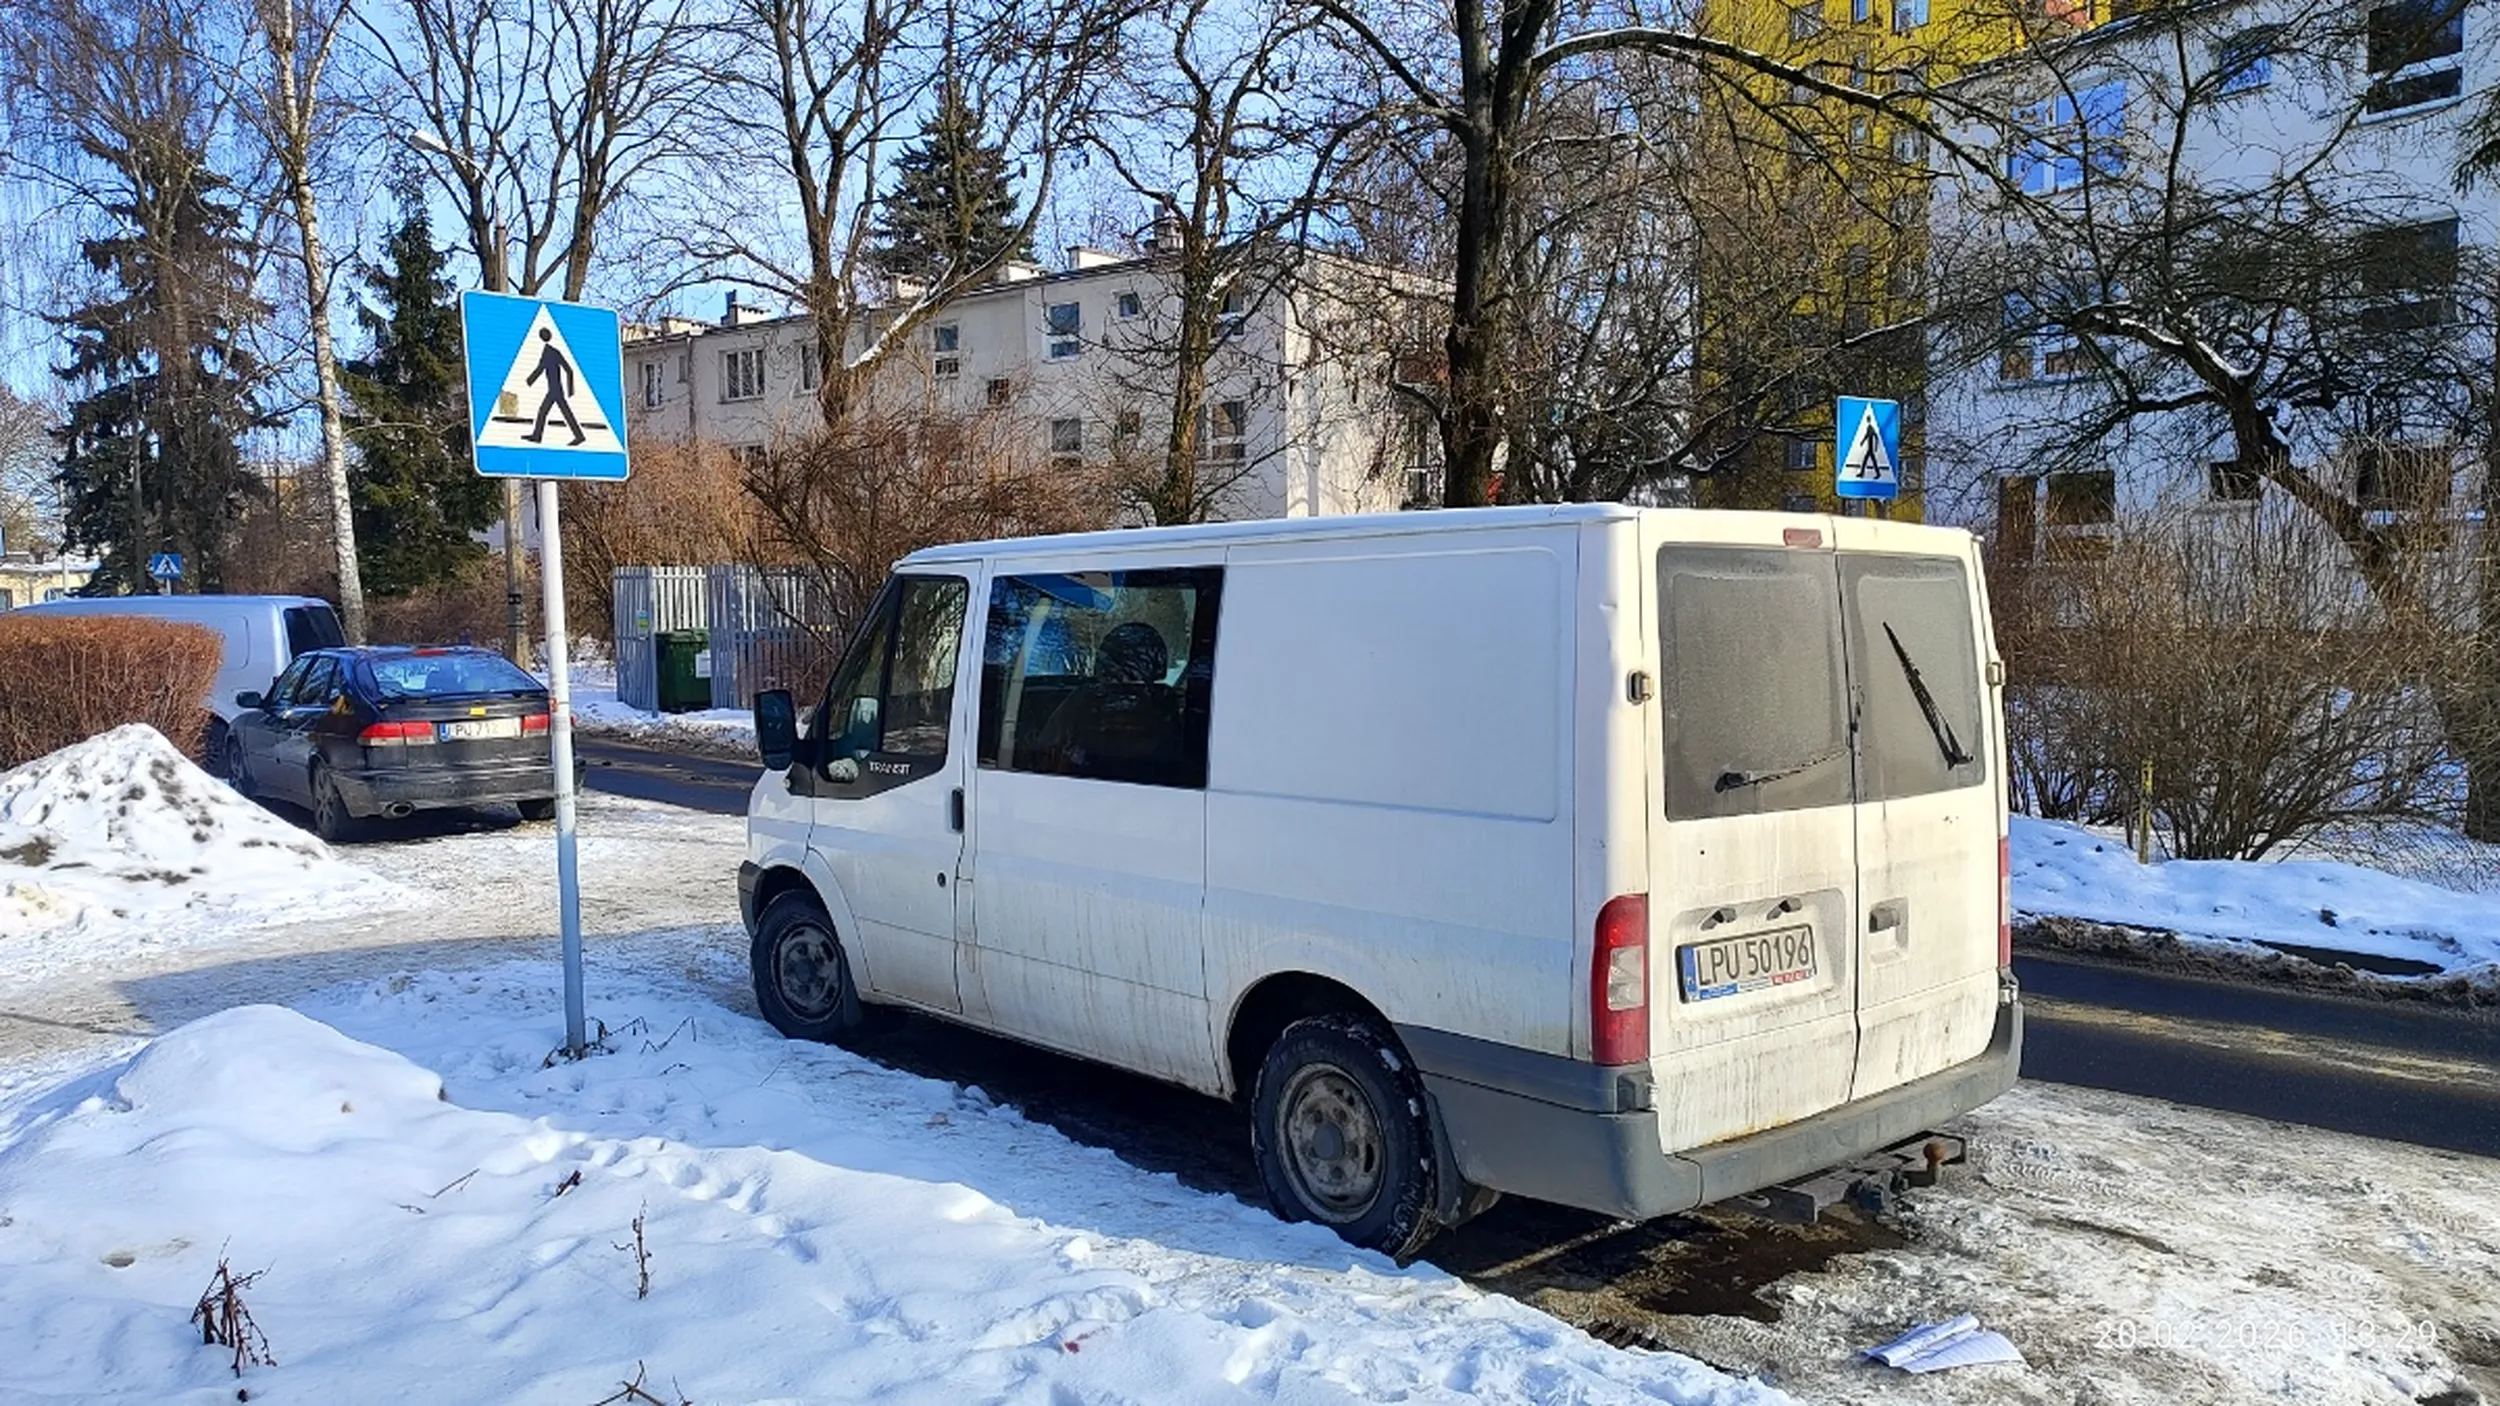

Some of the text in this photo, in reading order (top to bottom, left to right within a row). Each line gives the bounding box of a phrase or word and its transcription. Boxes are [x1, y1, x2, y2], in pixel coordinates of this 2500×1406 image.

[869, 761, 911, 775] TRANSIT
[1697, 931, 1809, 986] LPU 50196
